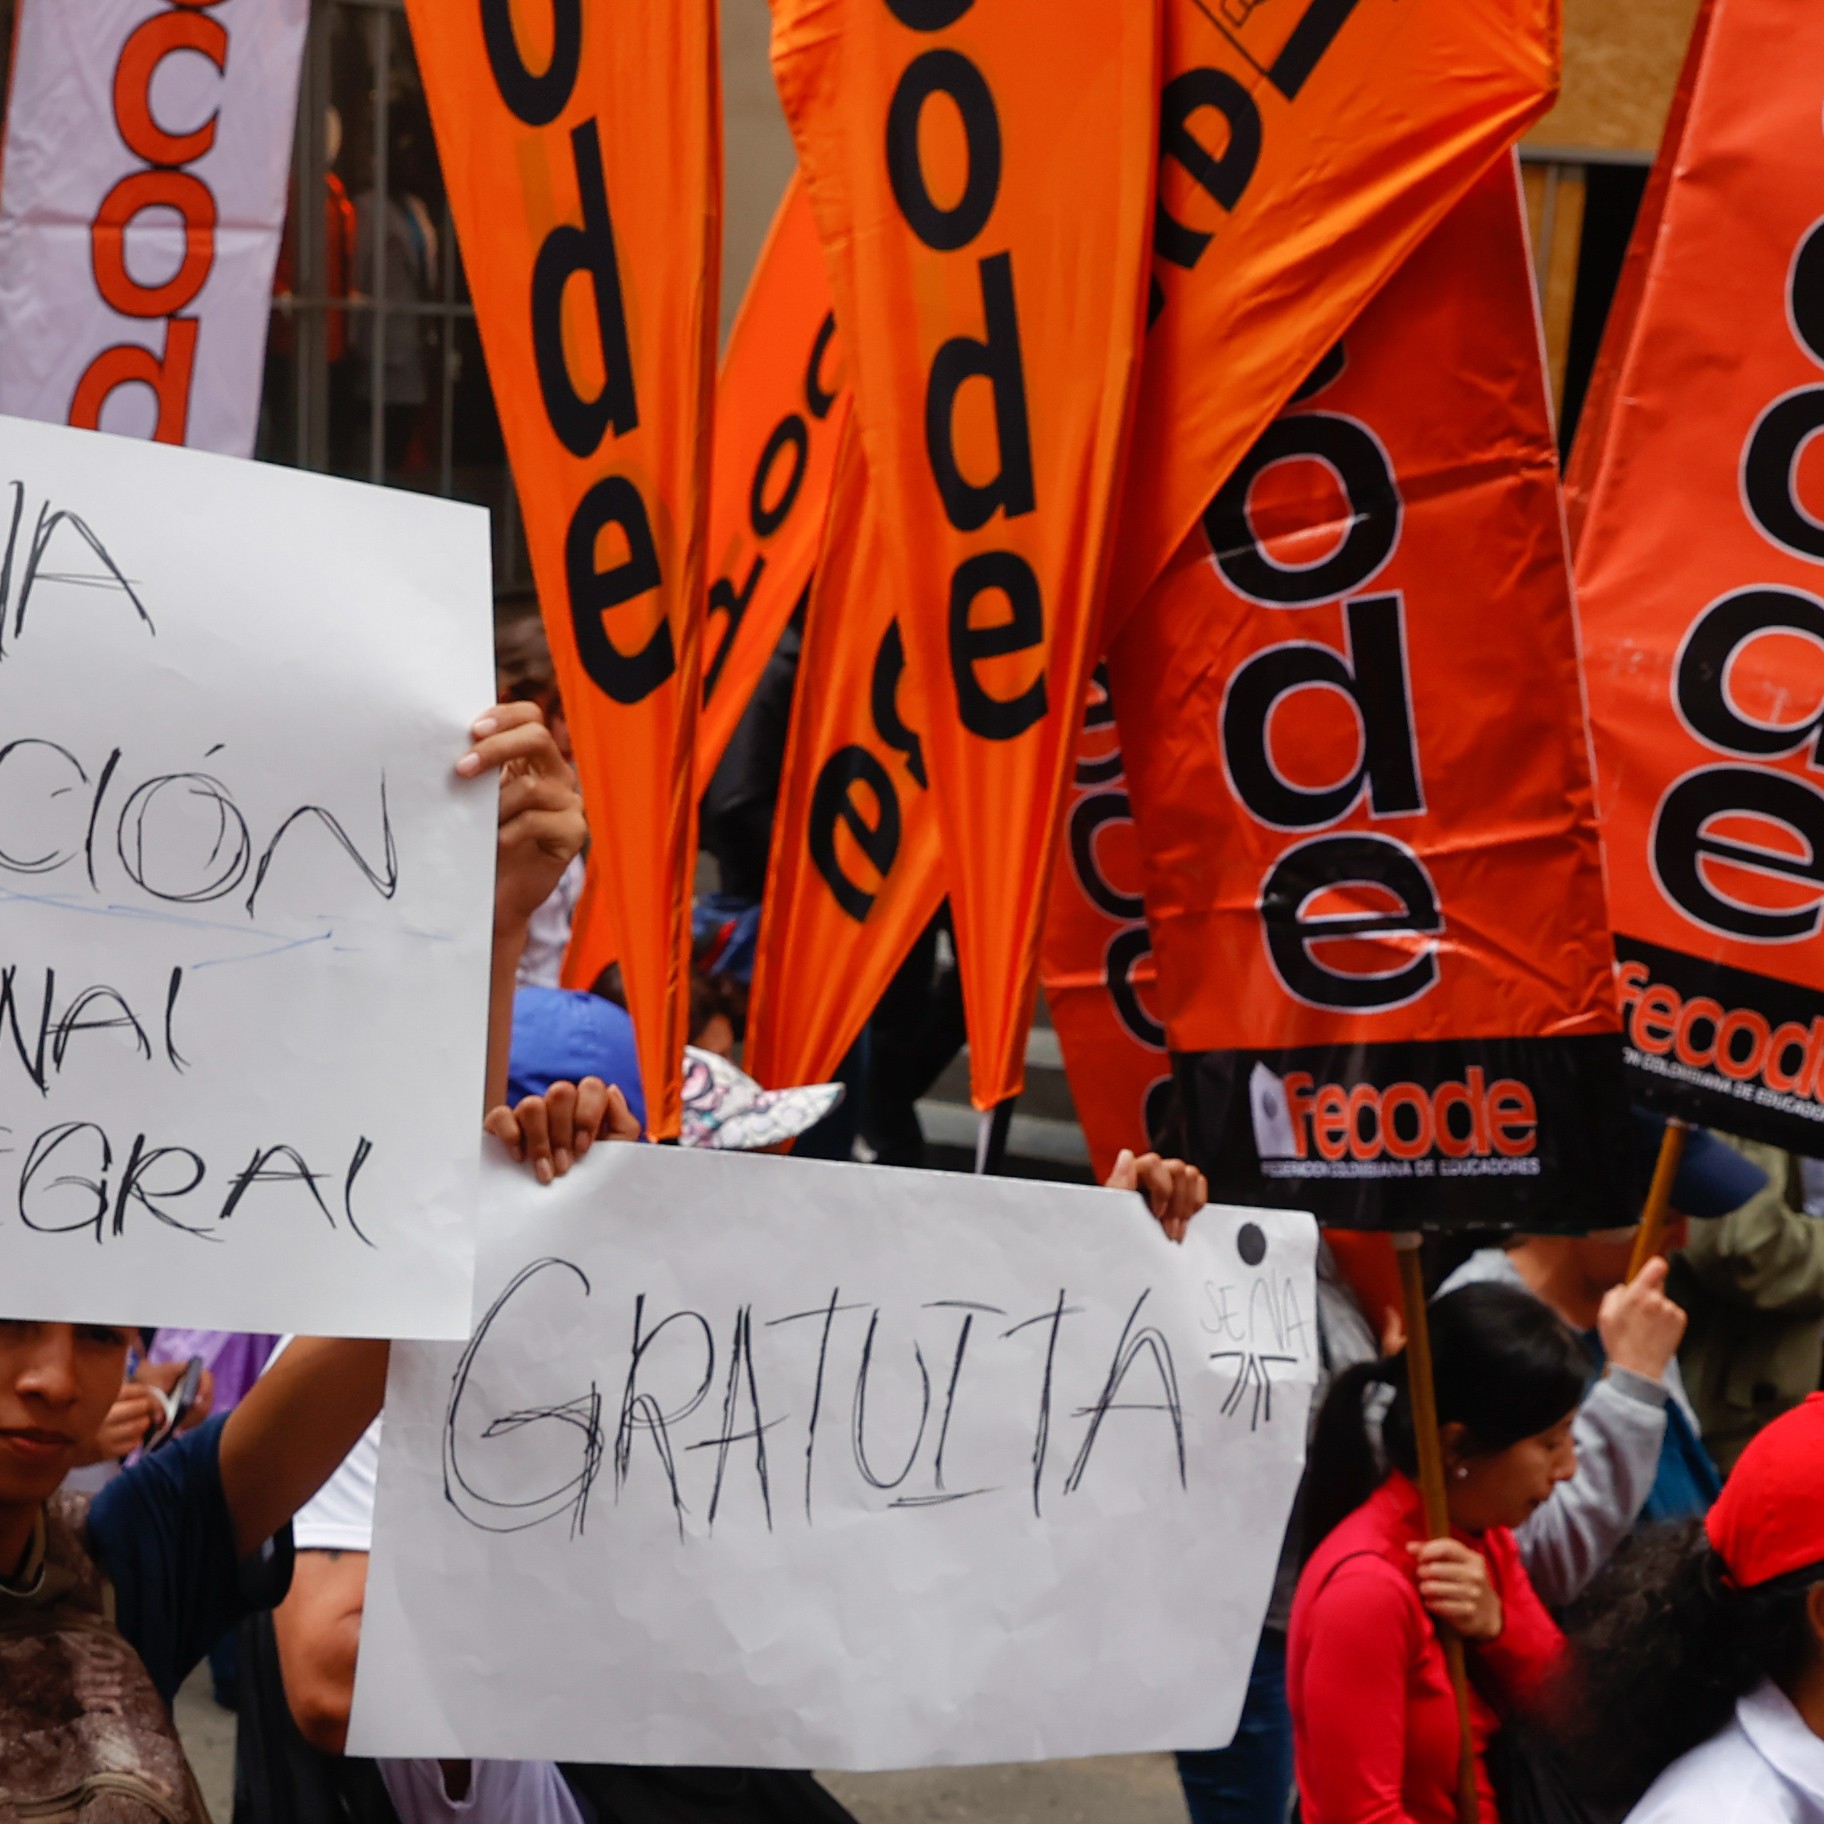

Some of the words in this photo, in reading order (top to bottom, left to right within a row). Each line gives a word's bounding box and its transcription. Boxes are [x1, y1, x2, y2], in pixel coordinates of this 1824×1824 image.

[66, 0, 229, 446] cod
[884, 0, 1049, 741] ode
[1201, 342, 1446, 1015] ode
[1282, 1065, 1539, 1162] fecode
[441, 1256, 1187, 1544] GRATUITA
[1200, 1267, 1312, 1359] SENA
